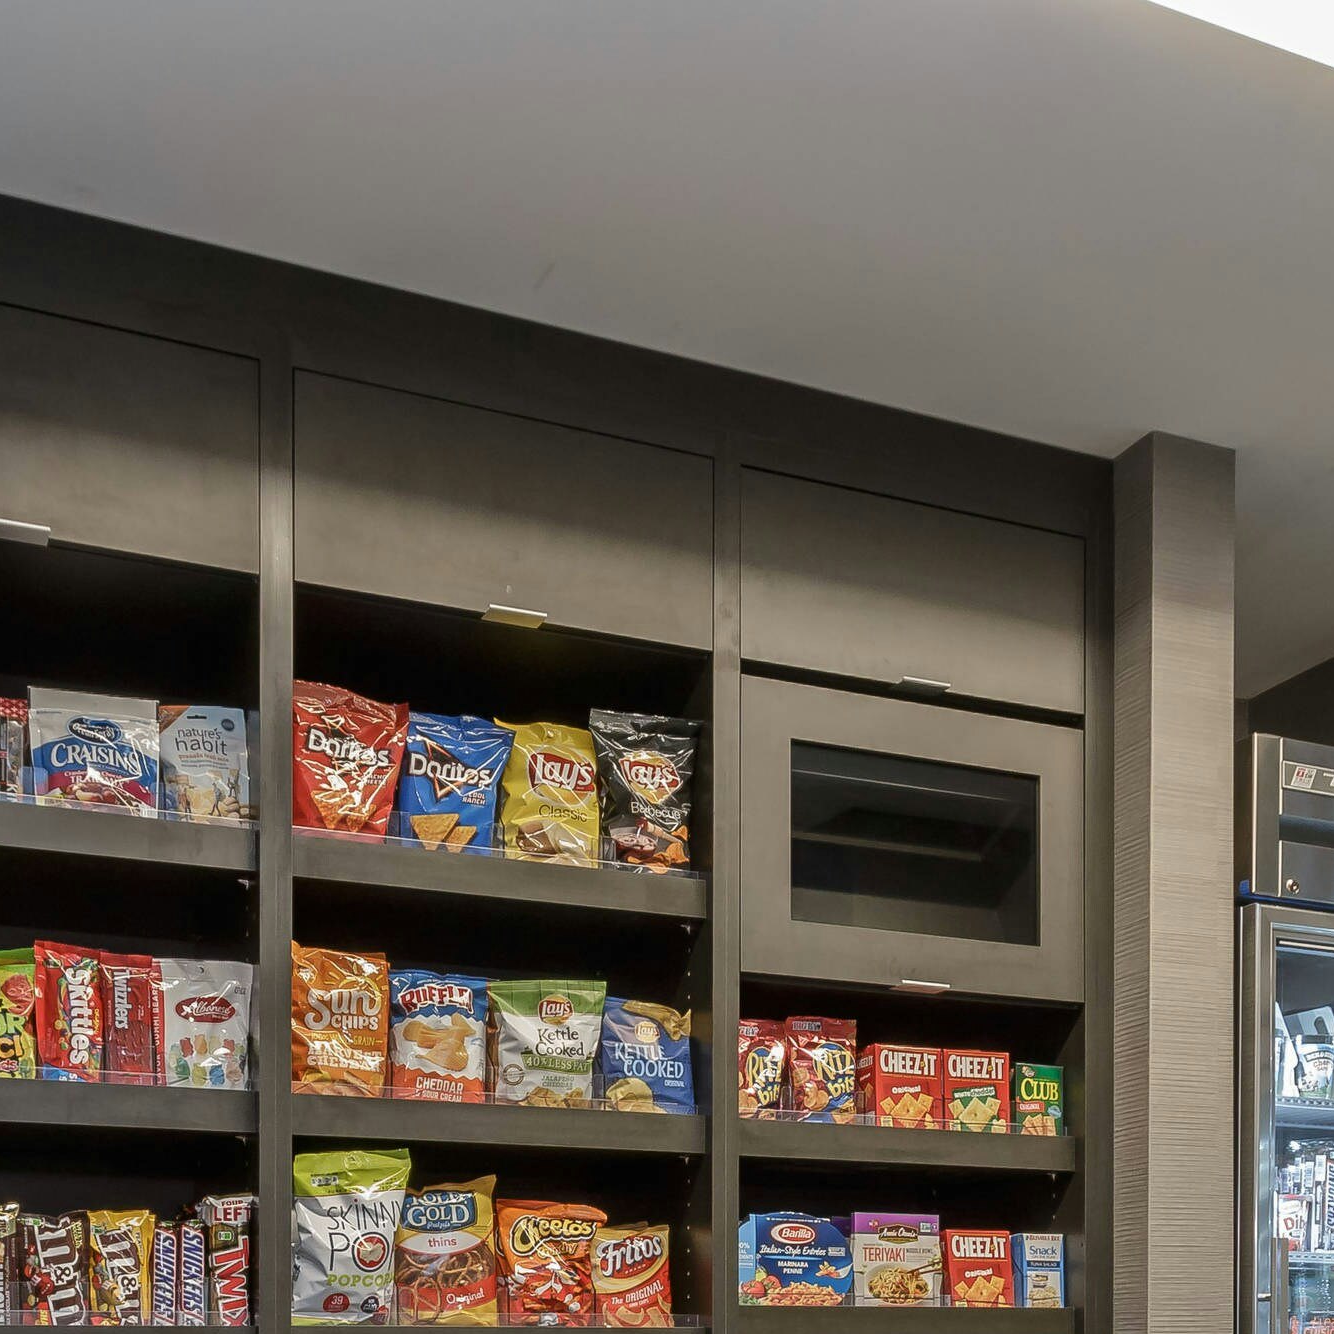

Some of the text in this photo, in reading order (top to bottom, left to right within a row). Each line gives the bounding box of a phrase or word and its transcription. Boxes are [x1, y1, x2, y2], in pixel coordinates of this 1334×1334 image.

[177, 727, 222, 741] nature's
[175, 737, 228, 756] habit
[307, 727, 390, 767] Doritos
[51, 742, 141, 777] CRAISINS
[408, 752, 492, 788] Doritos
[535, 753, 595, 791] Lay's
[538, 804, 588, 822] Classic
[631, 801, 681, 821] Barbecue
[113, 968, 133, 1030] Twizzlers
[66, 968, 91, 1066] Skittles
[304, 988, 383, 1031] Sun
[331, 1014, 380, 1031] CHIPS
[538, 1027, 580, 1042] Kettle
[535, 1043, 585, 1057] Cooked
[615, 1042, 668, 1061] KETTLE
[548, 1058, 572, 1070] LESS
[623, 1060, 685, 1078] COOKED
[416, 1076, 465, 1094] CHEDDAR
[1020, 1078, 1059, 1101] CLUB
[440, 1092, 463, 1103] CREAM
[213, 1207, 252, 1222] LEFT
[406, 1204, 470, 1227] GOLD
[427, 1236, 457, 1249] thins
[781, 1228, 812, 1240] Barilla
[328, 1231, 396, 1273] PO
[596, 1235, 663, 1278] Fritos
[862, 1247, 906, 1263] TERIYAKI
[1029, 1245, 1058, 1256] Snack
[154, 1230, 176, 1323] SNICKERS
[182, 1225, 205, 1319] SNICKERS
[783, 1267, 803, 1275] PENNE
[446, 1287, 486, 1305] Original
[625, 1279, 664, 1303] ORIGINAL
